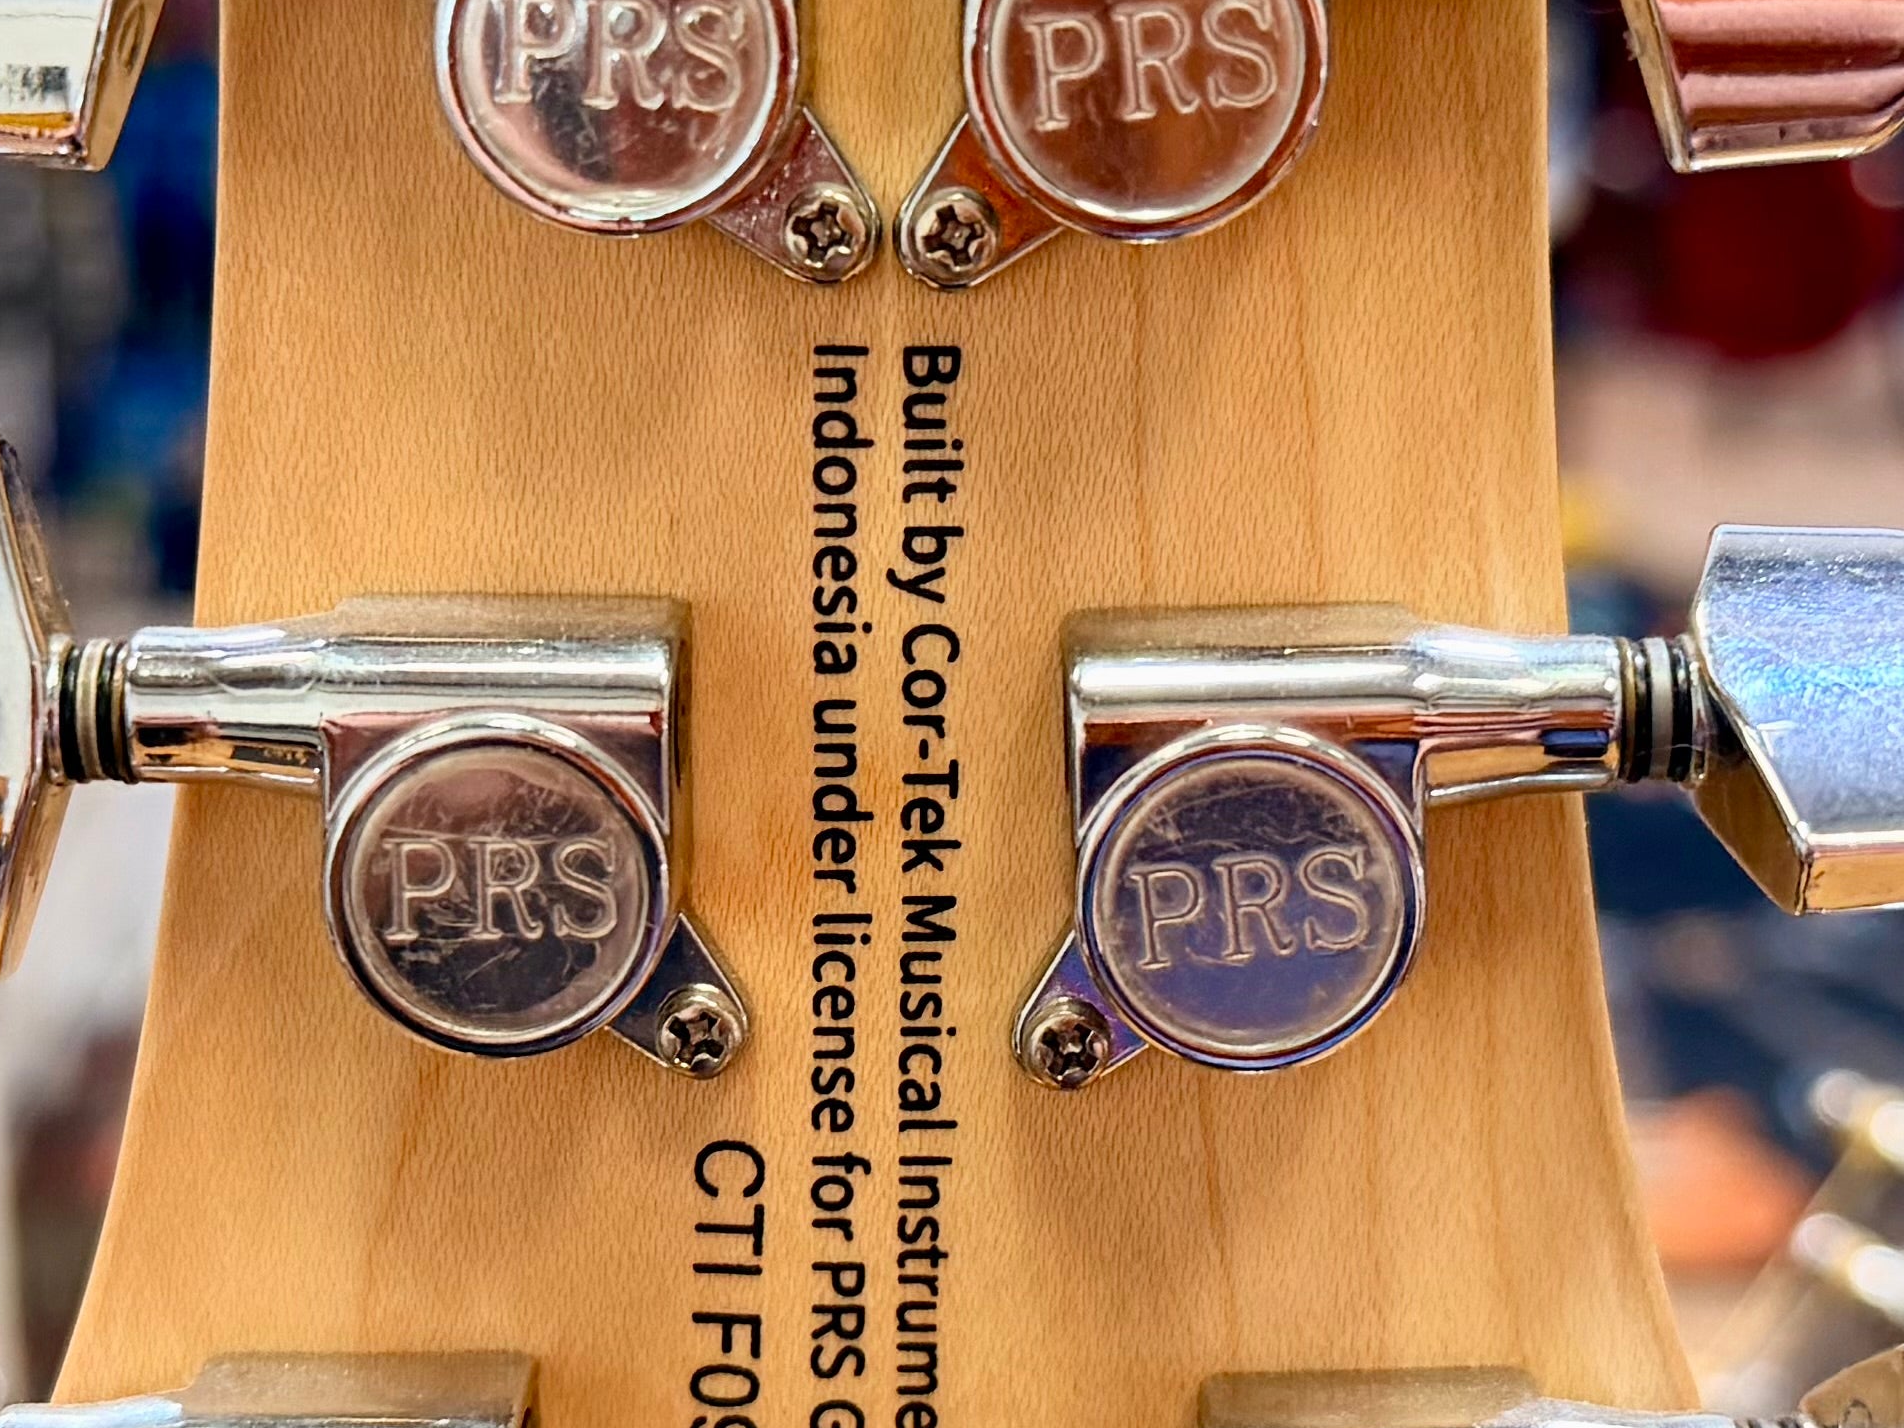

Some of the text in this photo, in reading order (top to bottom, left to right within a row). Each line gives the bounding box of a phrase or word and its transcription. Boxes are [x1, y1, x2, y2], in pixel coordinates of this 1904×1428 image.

[902, 344, 965, 504] Built
[812, 343, 875, 676] Indonesia
[885, 525, 965, 605] by
[811, 698, 875, 895] under
[900, 623, 962, 874] Cor-Tek
[380, 834, 620, 944] PRS
[1132, 844, 1376, 972] PRS
[810, 913, 873, 1133] license
[897, 895, 959, 1133] Musical
[692, 1139, 766, 1277] CTI
[810, 1151, 872, 1243] for
[810, 1261, 866, 1380] PRS
